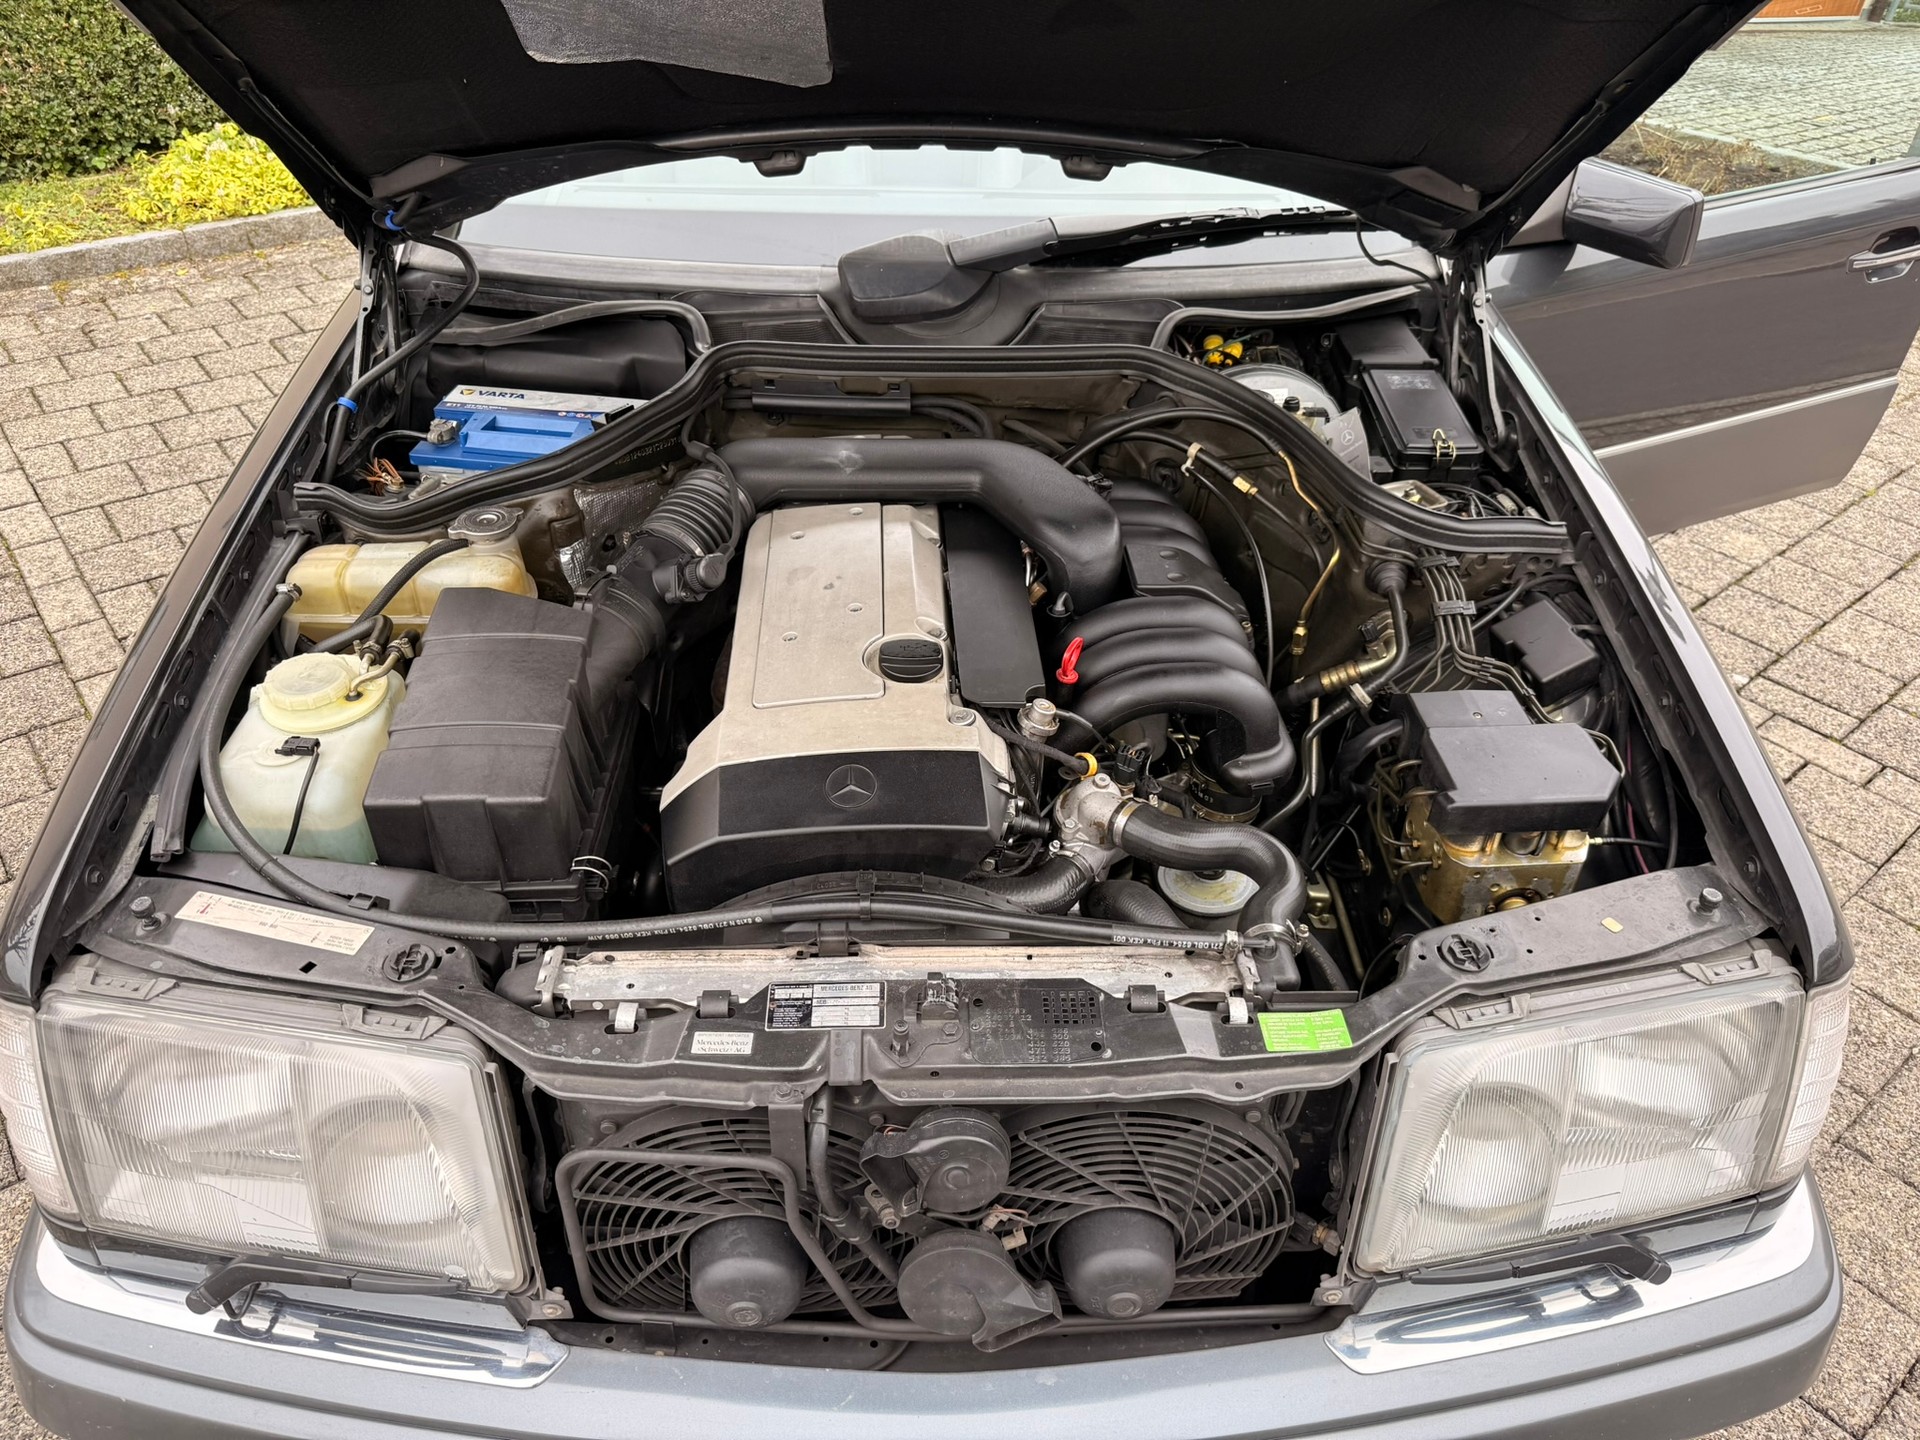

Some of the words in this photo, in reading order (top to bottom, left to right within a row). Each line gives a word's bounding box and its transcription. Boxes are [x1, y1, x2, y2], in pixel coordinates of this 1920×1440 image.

[479, 390, 525, 400] VARTA
[1113, 935, 1126, 943] 001
[1163, 939, 1192, 948] 6254.11
[1194, 941, 1208, 949] DBL
[1210, 942, 1223, 950] 271
